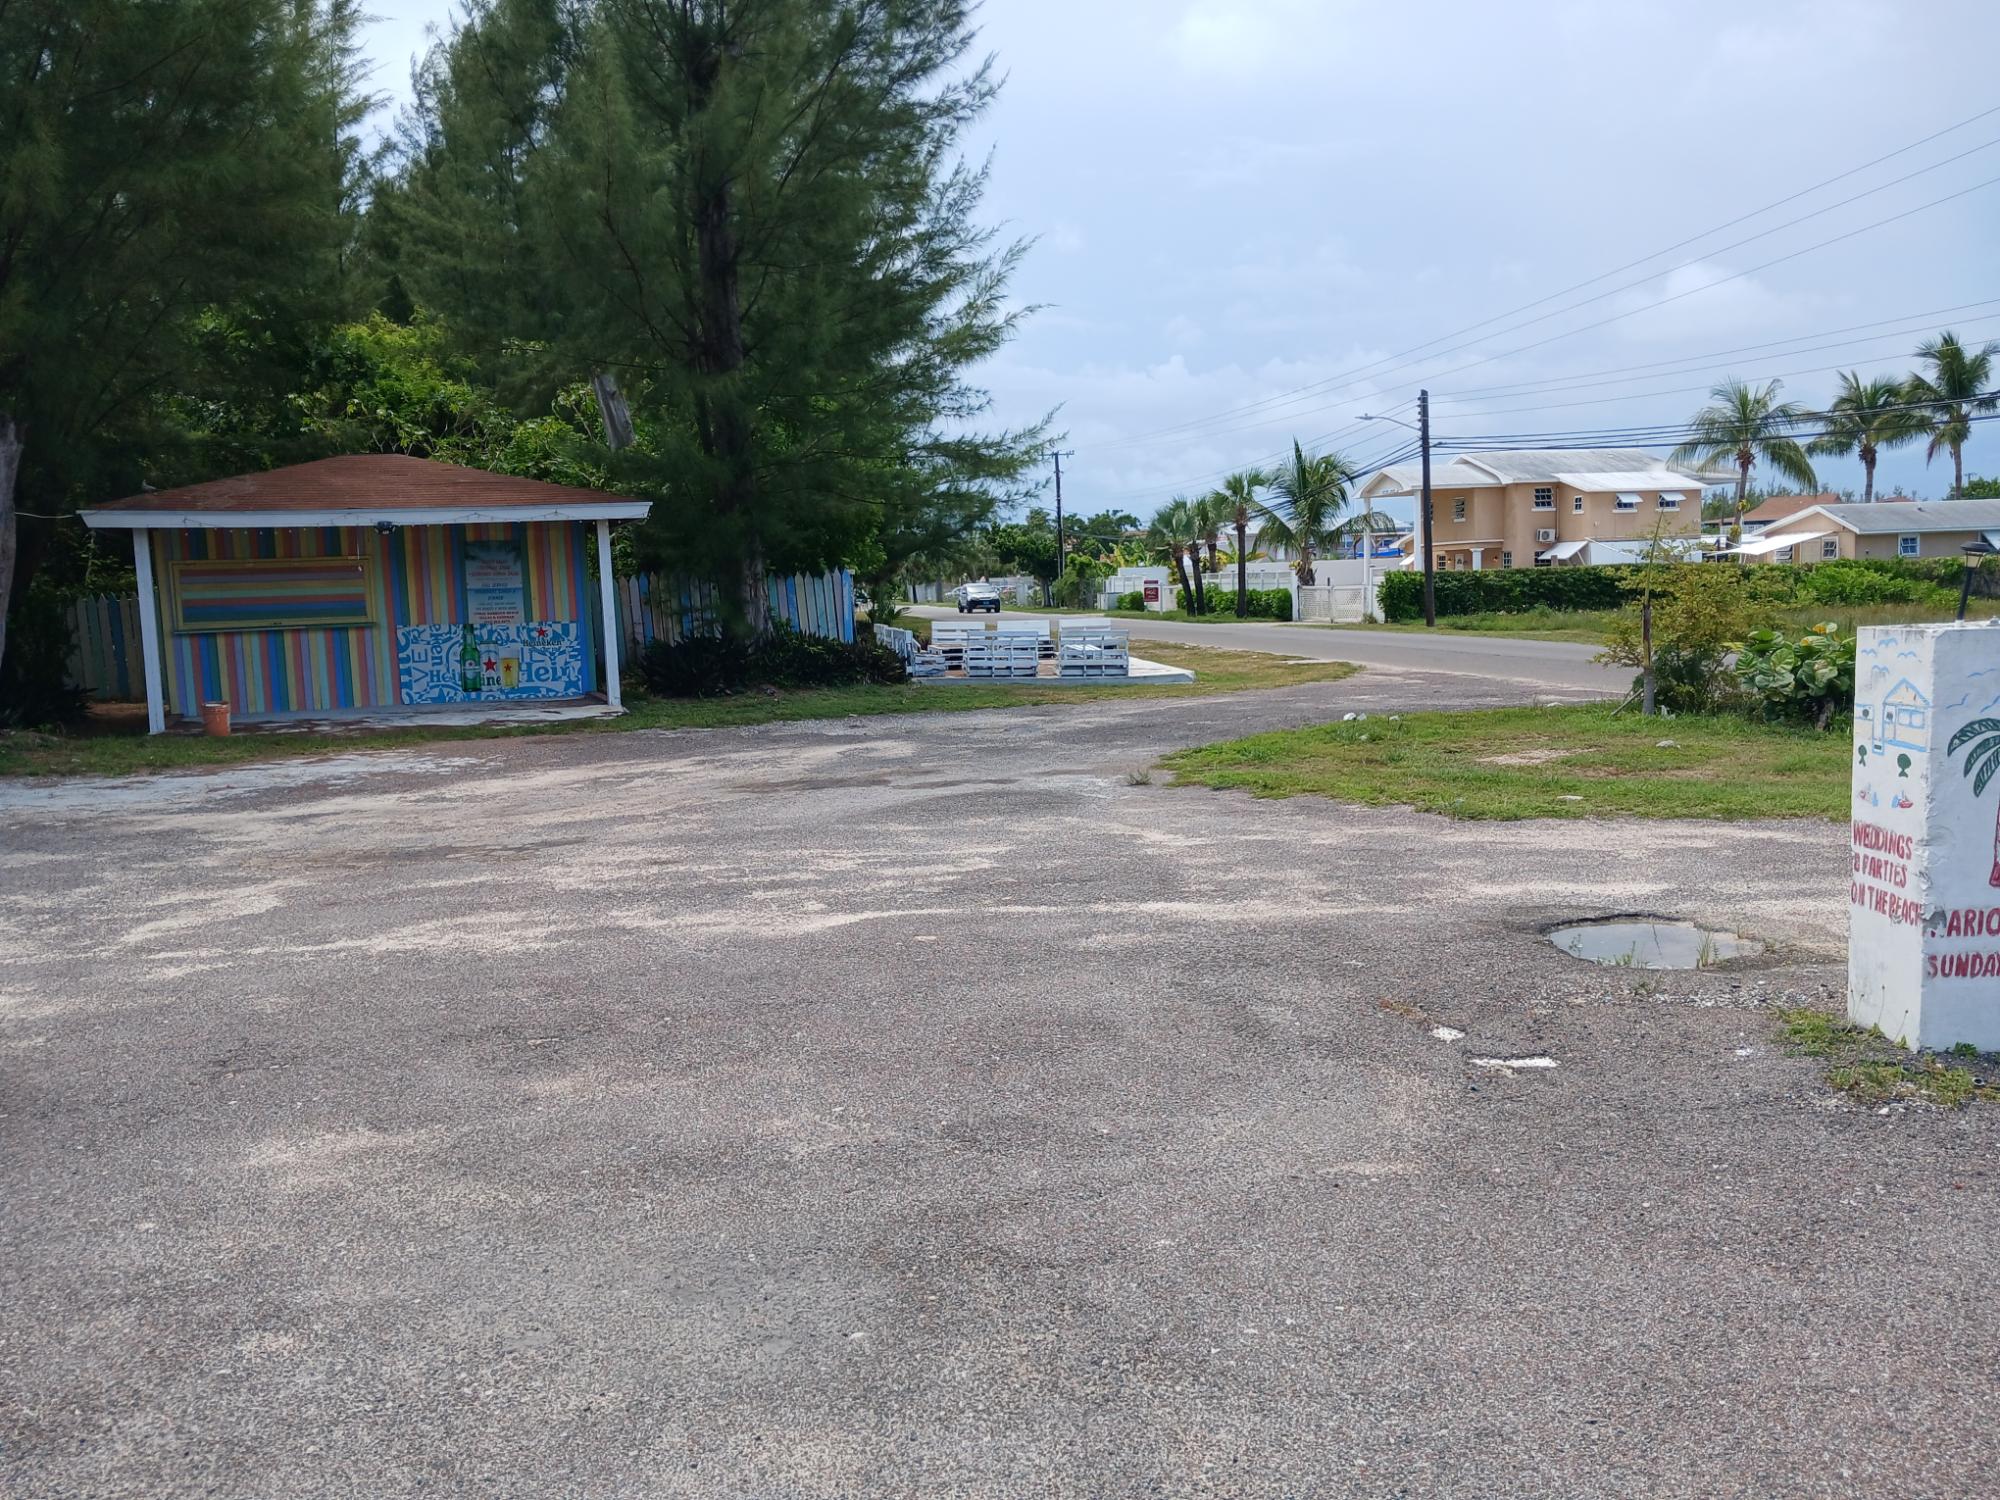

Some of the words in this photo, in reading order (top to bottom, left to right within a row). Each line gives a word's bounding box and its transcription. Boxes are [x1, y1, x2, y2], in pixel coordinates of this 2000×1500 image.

[1853, 822, 1912, 860] WEDDINGS
[1861, 855, 1907, 888] PARTIES
[1850, 881, 1865, 906] ON
[1868, 885, 1888, 915] THE
[1930, 908, 2000, 937] ARIO
